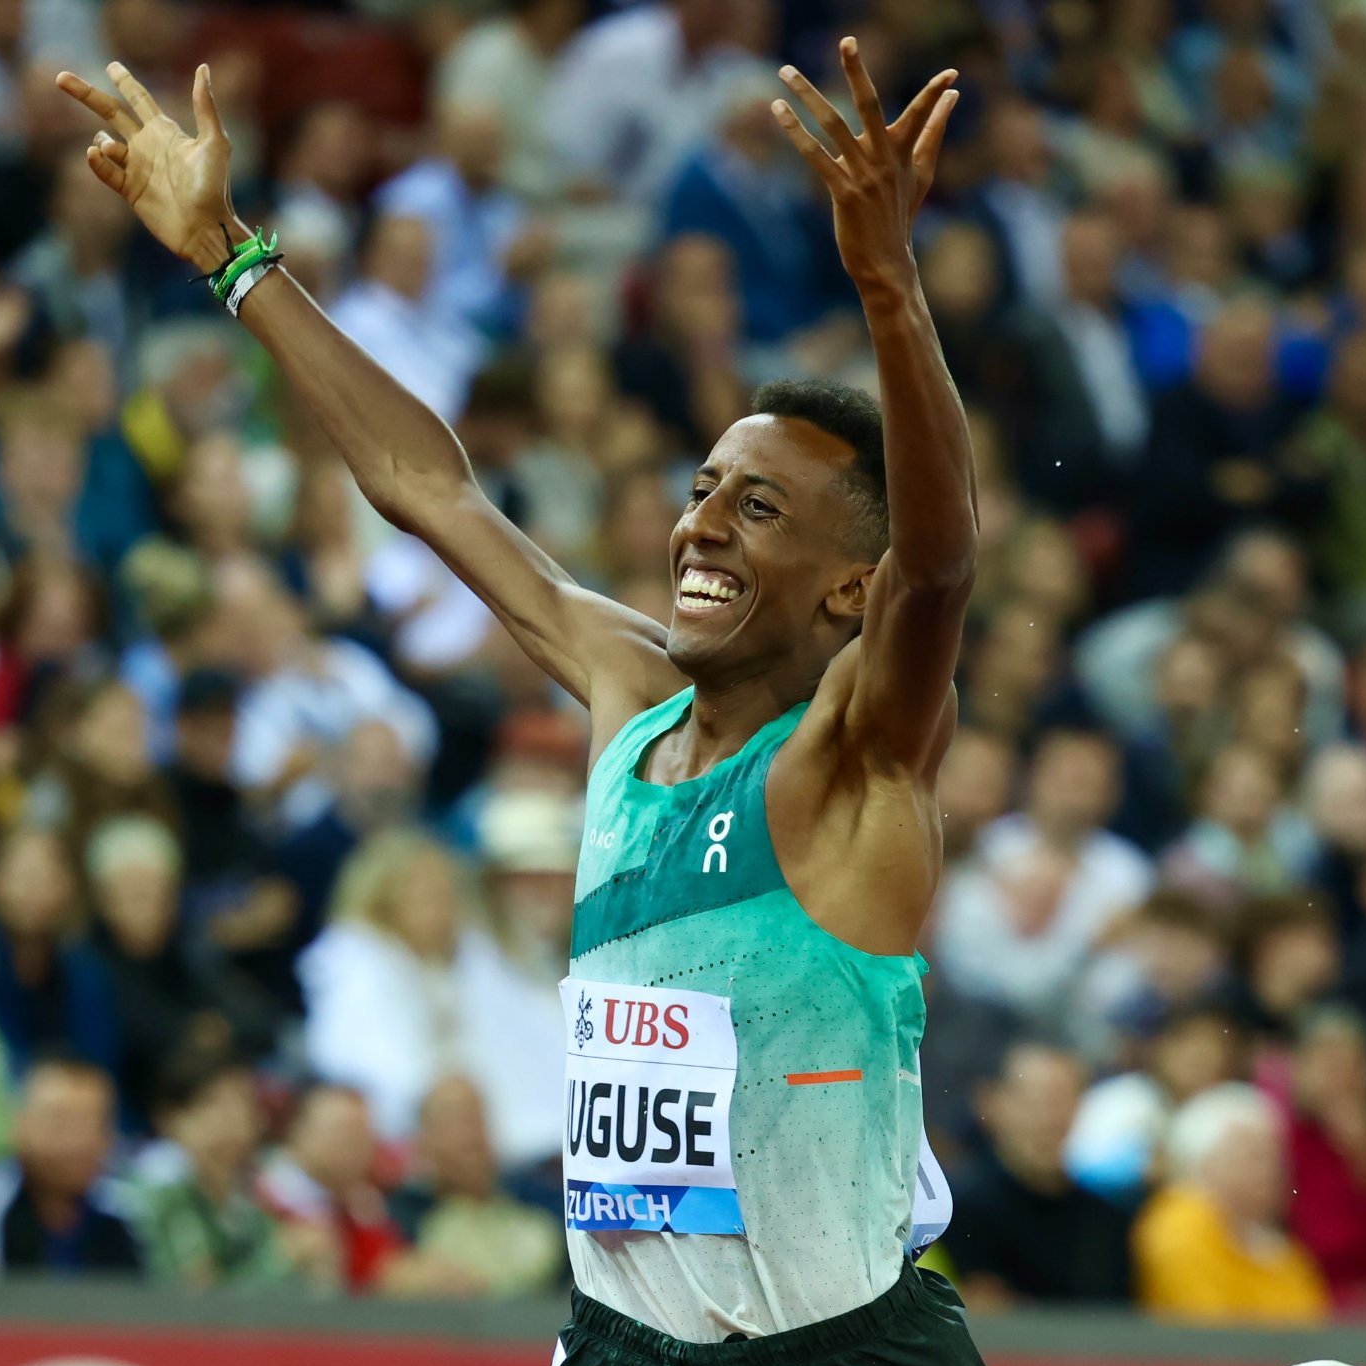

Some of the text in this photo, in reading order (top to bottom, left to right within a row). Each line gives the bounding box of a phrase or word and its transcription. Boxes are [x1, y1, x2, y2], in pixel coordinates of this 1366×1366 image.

[603, 998, 690, 1049] UBS
[567, 1079, 717, 1167] UGUSE
[567, 1189, 671, 1222] ZURICH
